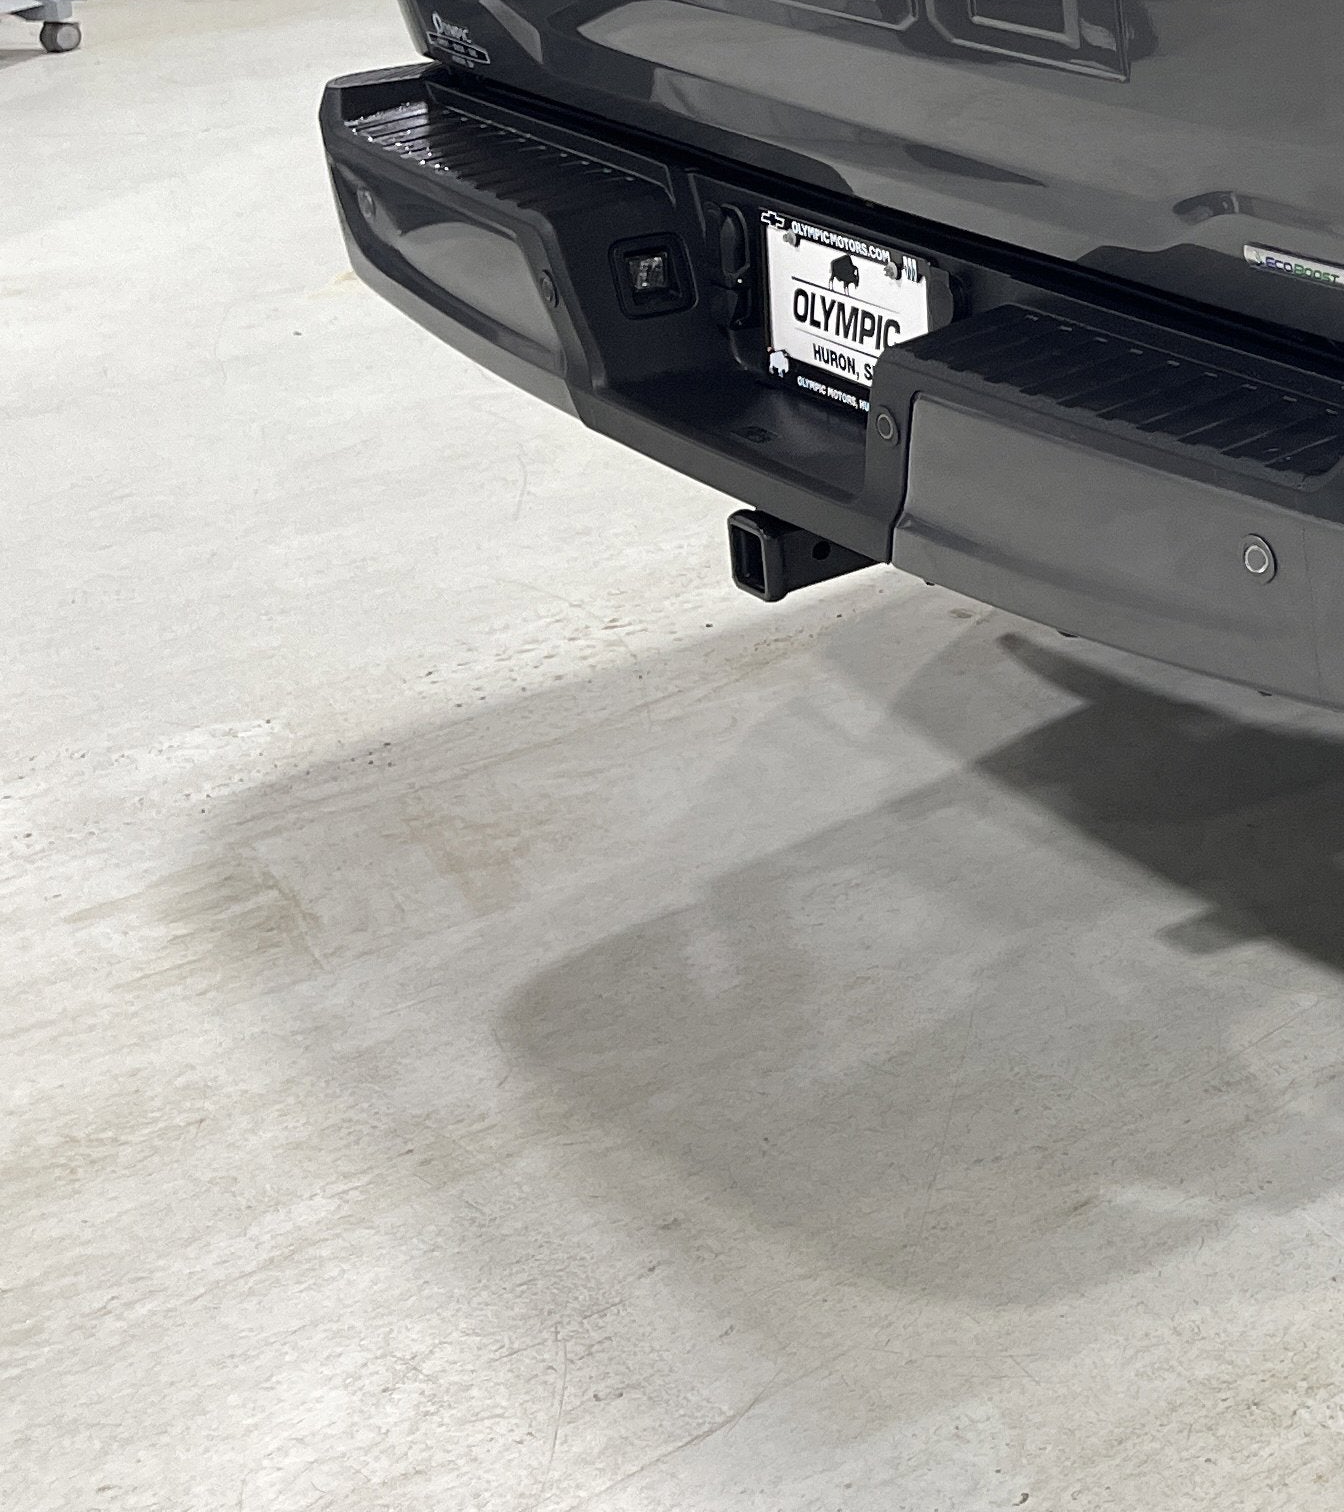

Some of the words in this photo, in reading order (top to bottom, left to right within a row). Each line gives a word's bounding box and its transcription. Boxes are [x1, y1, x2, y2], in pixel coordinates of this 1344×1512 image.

[790, 220, 892, 264] OLYMPICMOTORS.COM
[793, 287, 901, 351] OLYMPIC
[812, 342, 860, 380] HURON,
[863, 362, 875, 381] S
[796, 374, 827, 396] OLYMPIC
[827, 385, 859, 409] MOTORS,
